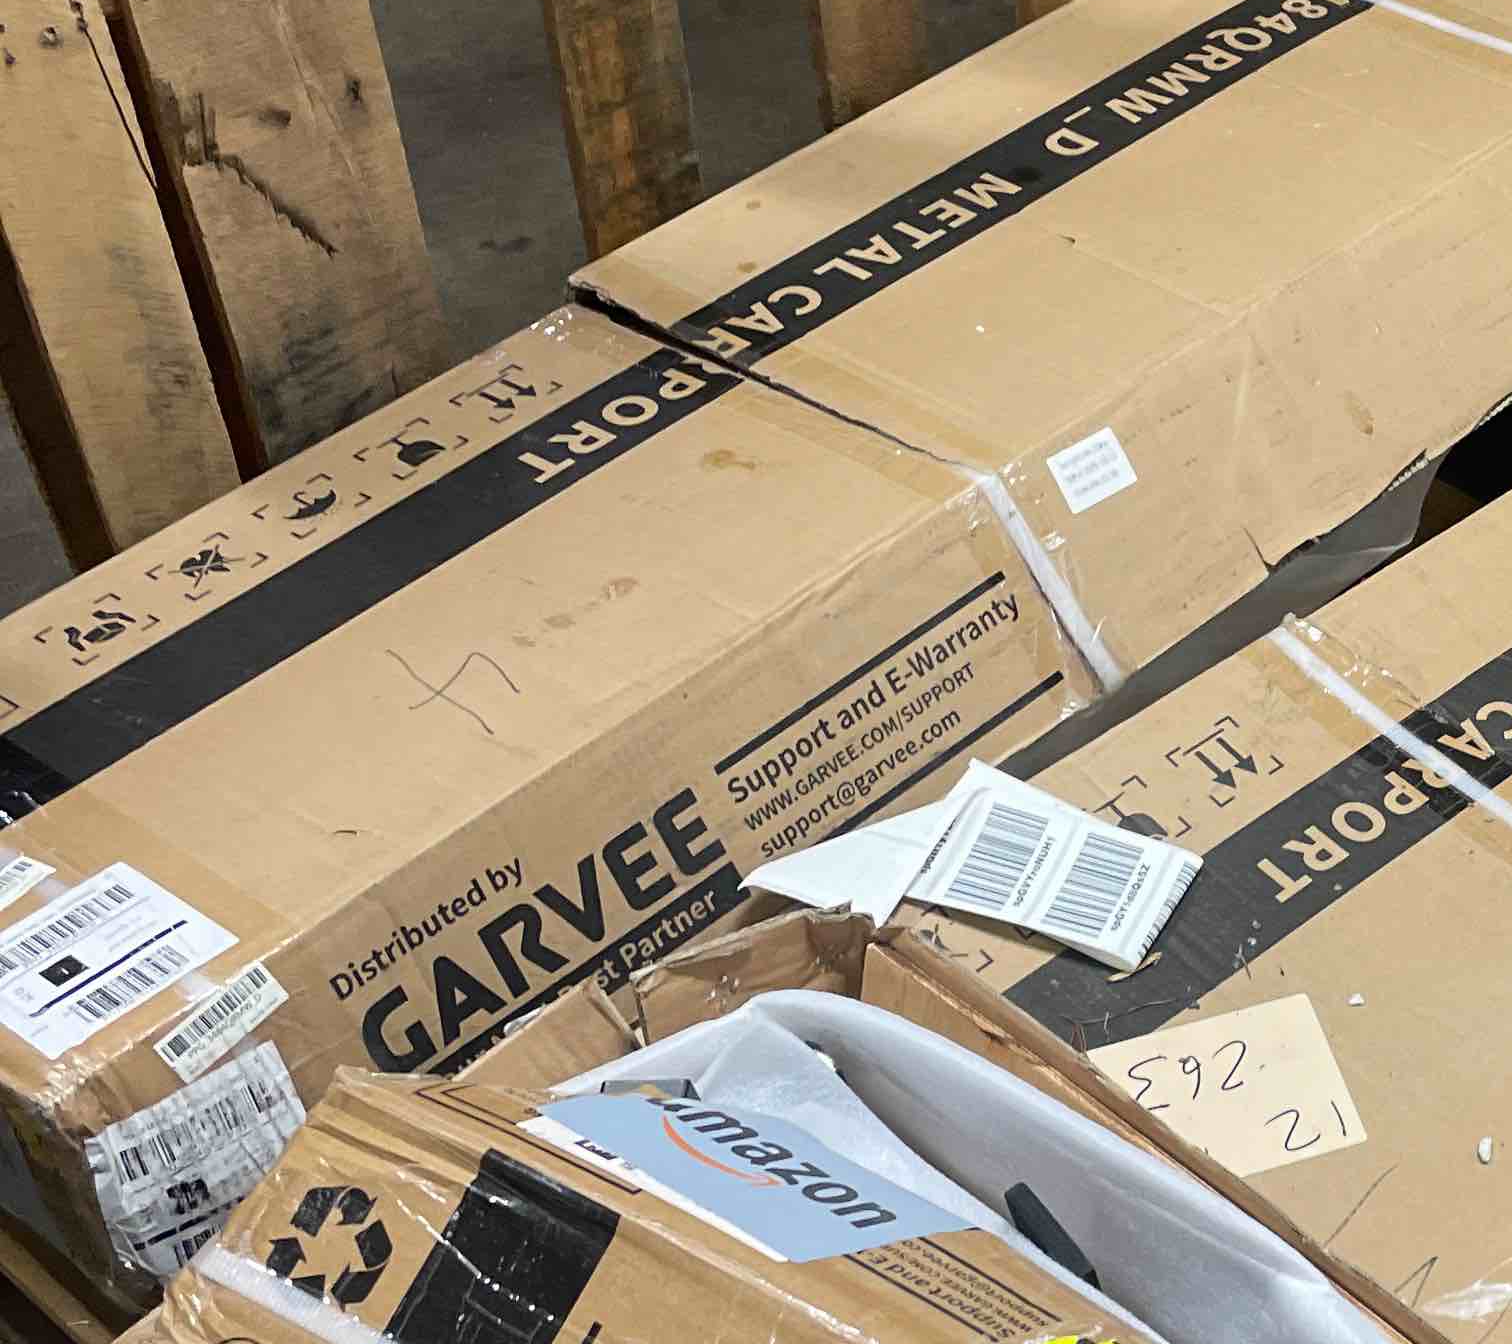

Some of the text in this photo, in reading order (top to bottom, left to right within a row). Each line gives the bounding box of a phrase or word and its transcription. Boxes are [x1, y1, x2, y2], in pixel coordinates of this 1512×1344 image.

[813, 172, 1023, 281] METAL
[518, 285, 824, 484] CARPORT
[726, 593, 1020, 806] Support and E-Warranty
[744, 662, 976, 834] WWW.GARVEE.COM/SUPPORT
[760, 708, 962, 860] support@garvee.com
[328, 855, 526, 1001] Distributed by
[361, 787, 727, 1073] GARVEE
[619, 888, 718, 980] Partner
[1263, 1100, 1347, 1152] 12
[885, 1262, 931, 1288] and
